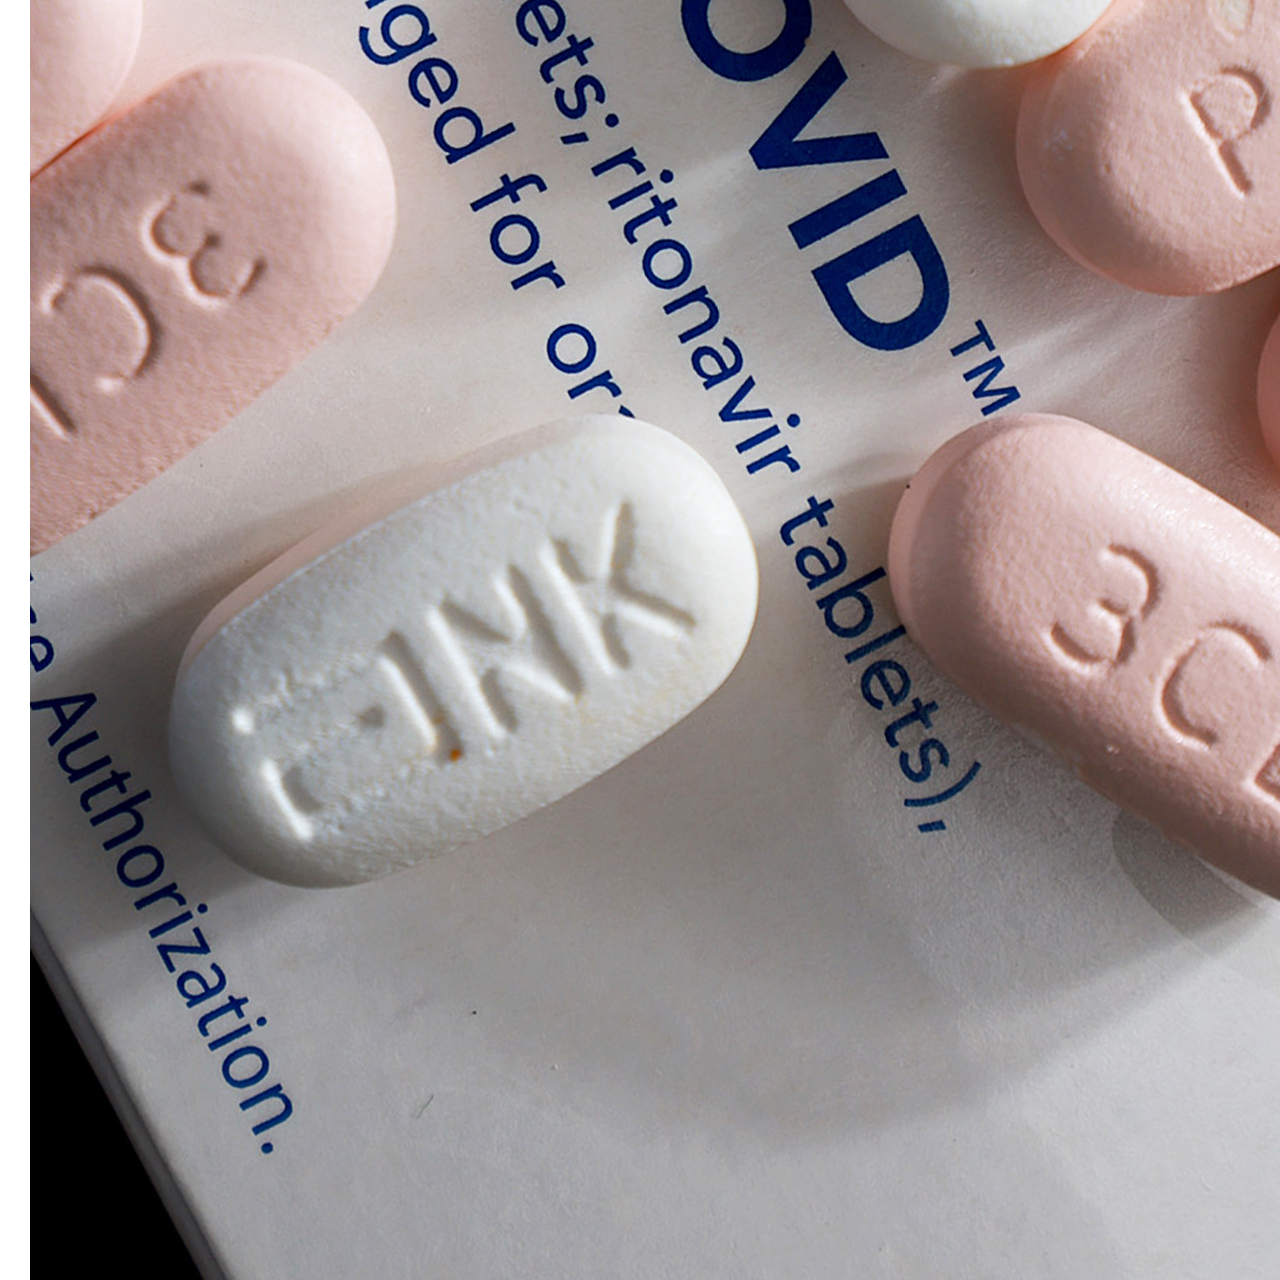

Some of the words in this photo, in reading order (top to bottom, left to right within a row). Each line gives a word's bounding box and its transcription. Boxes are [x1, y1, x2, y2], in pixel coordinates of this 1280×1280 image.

[471, 173, 566, 290] for
[546, 323, 636, 418] or
[592, 148, 801, 475] ritonavir
[780, 495, 982, 833] tablets),
[1044, 540, 1280, 804] 3C
[30, 692, 294, 1156] Authorization.
